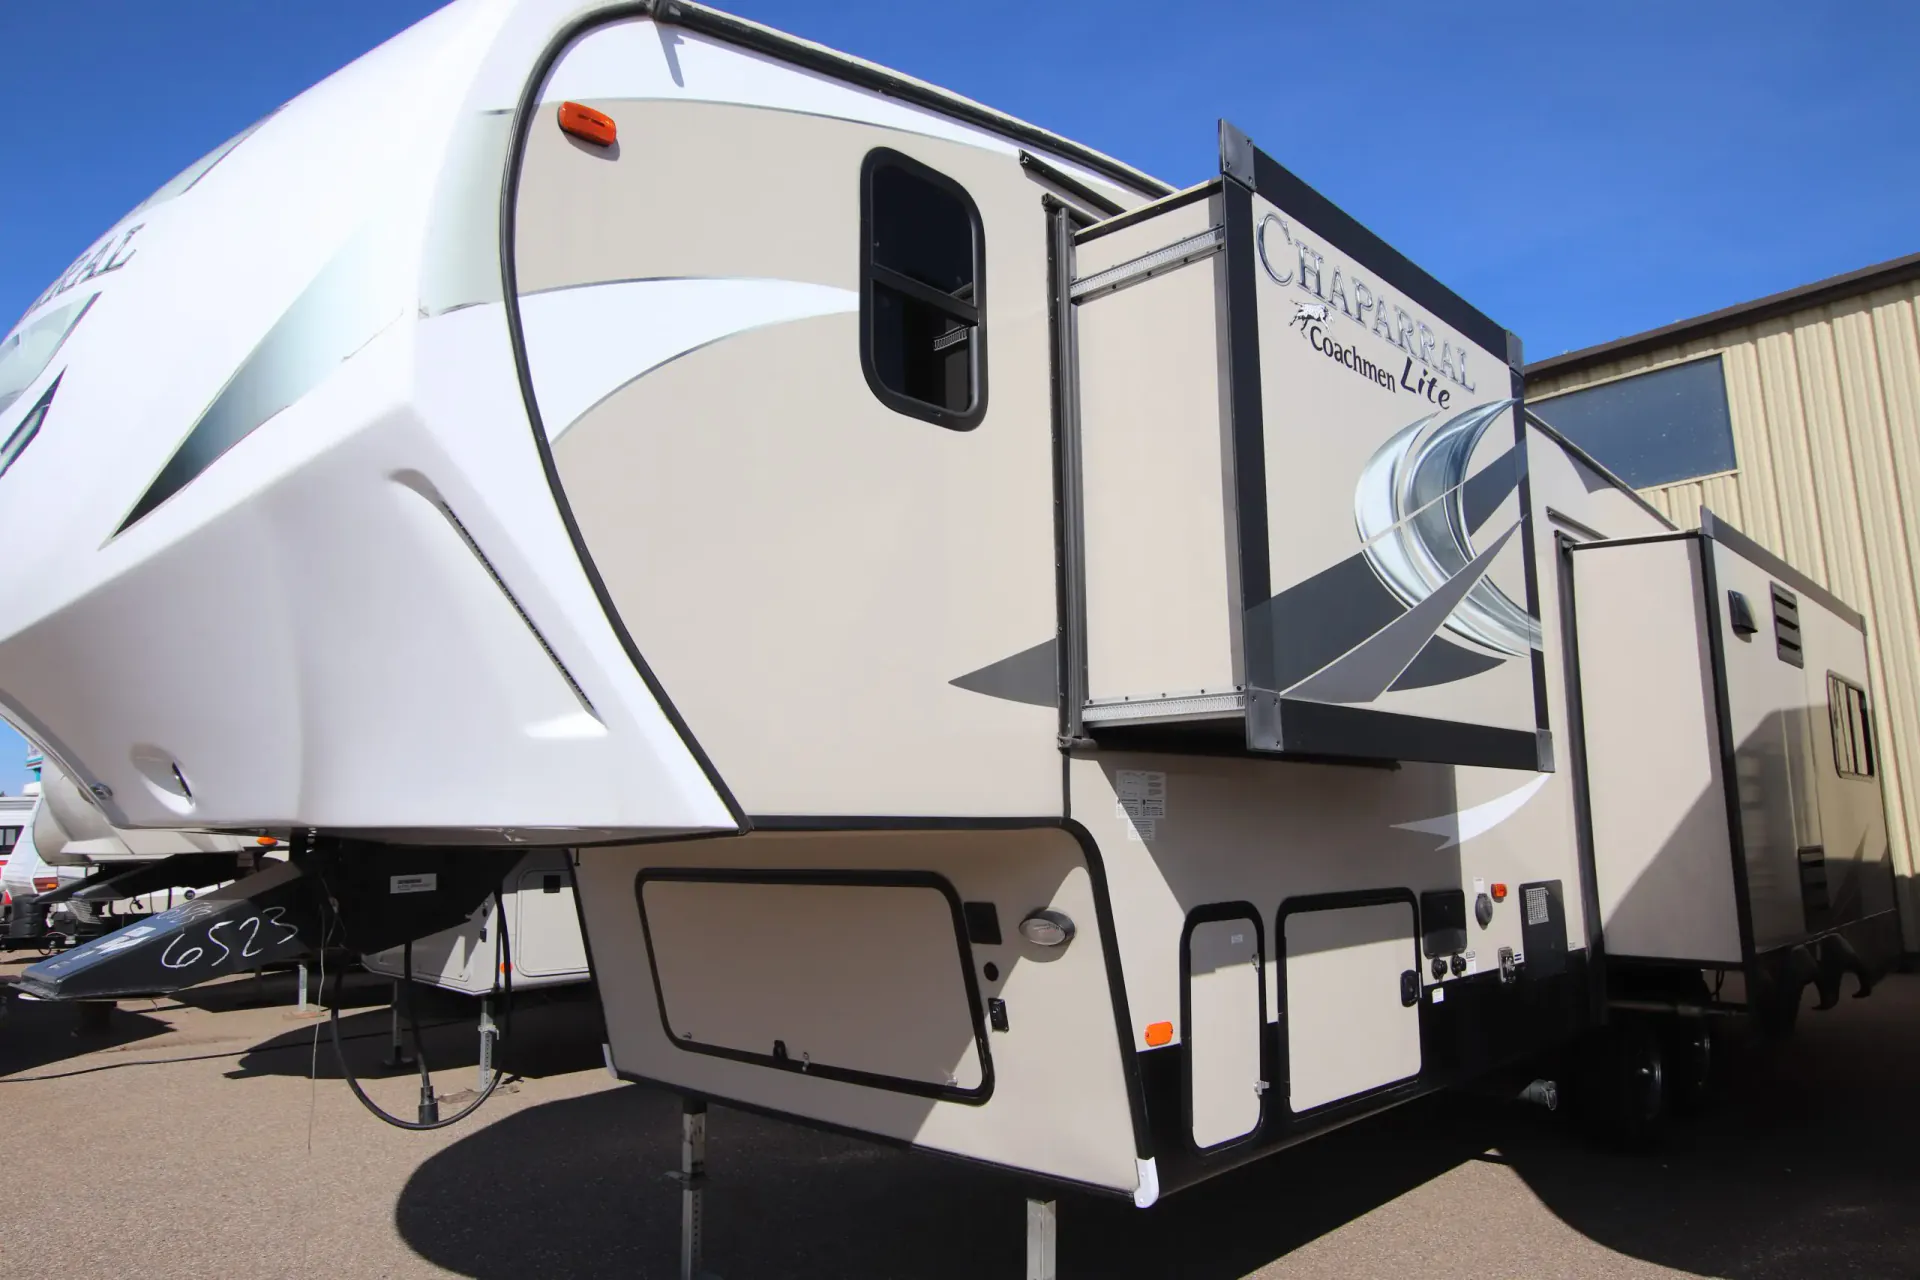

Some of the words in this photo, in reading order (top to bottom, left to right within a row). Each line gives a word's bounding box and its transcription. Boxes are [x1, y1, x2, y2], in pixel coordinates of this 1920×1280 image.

[1256, 211, 1476, 395] CHAPARRAL
[1309, 325, 1397, 394] Coachmen
[1399, 356, 1451, 411] Lite
[161, 906, 299, 969] 6523
